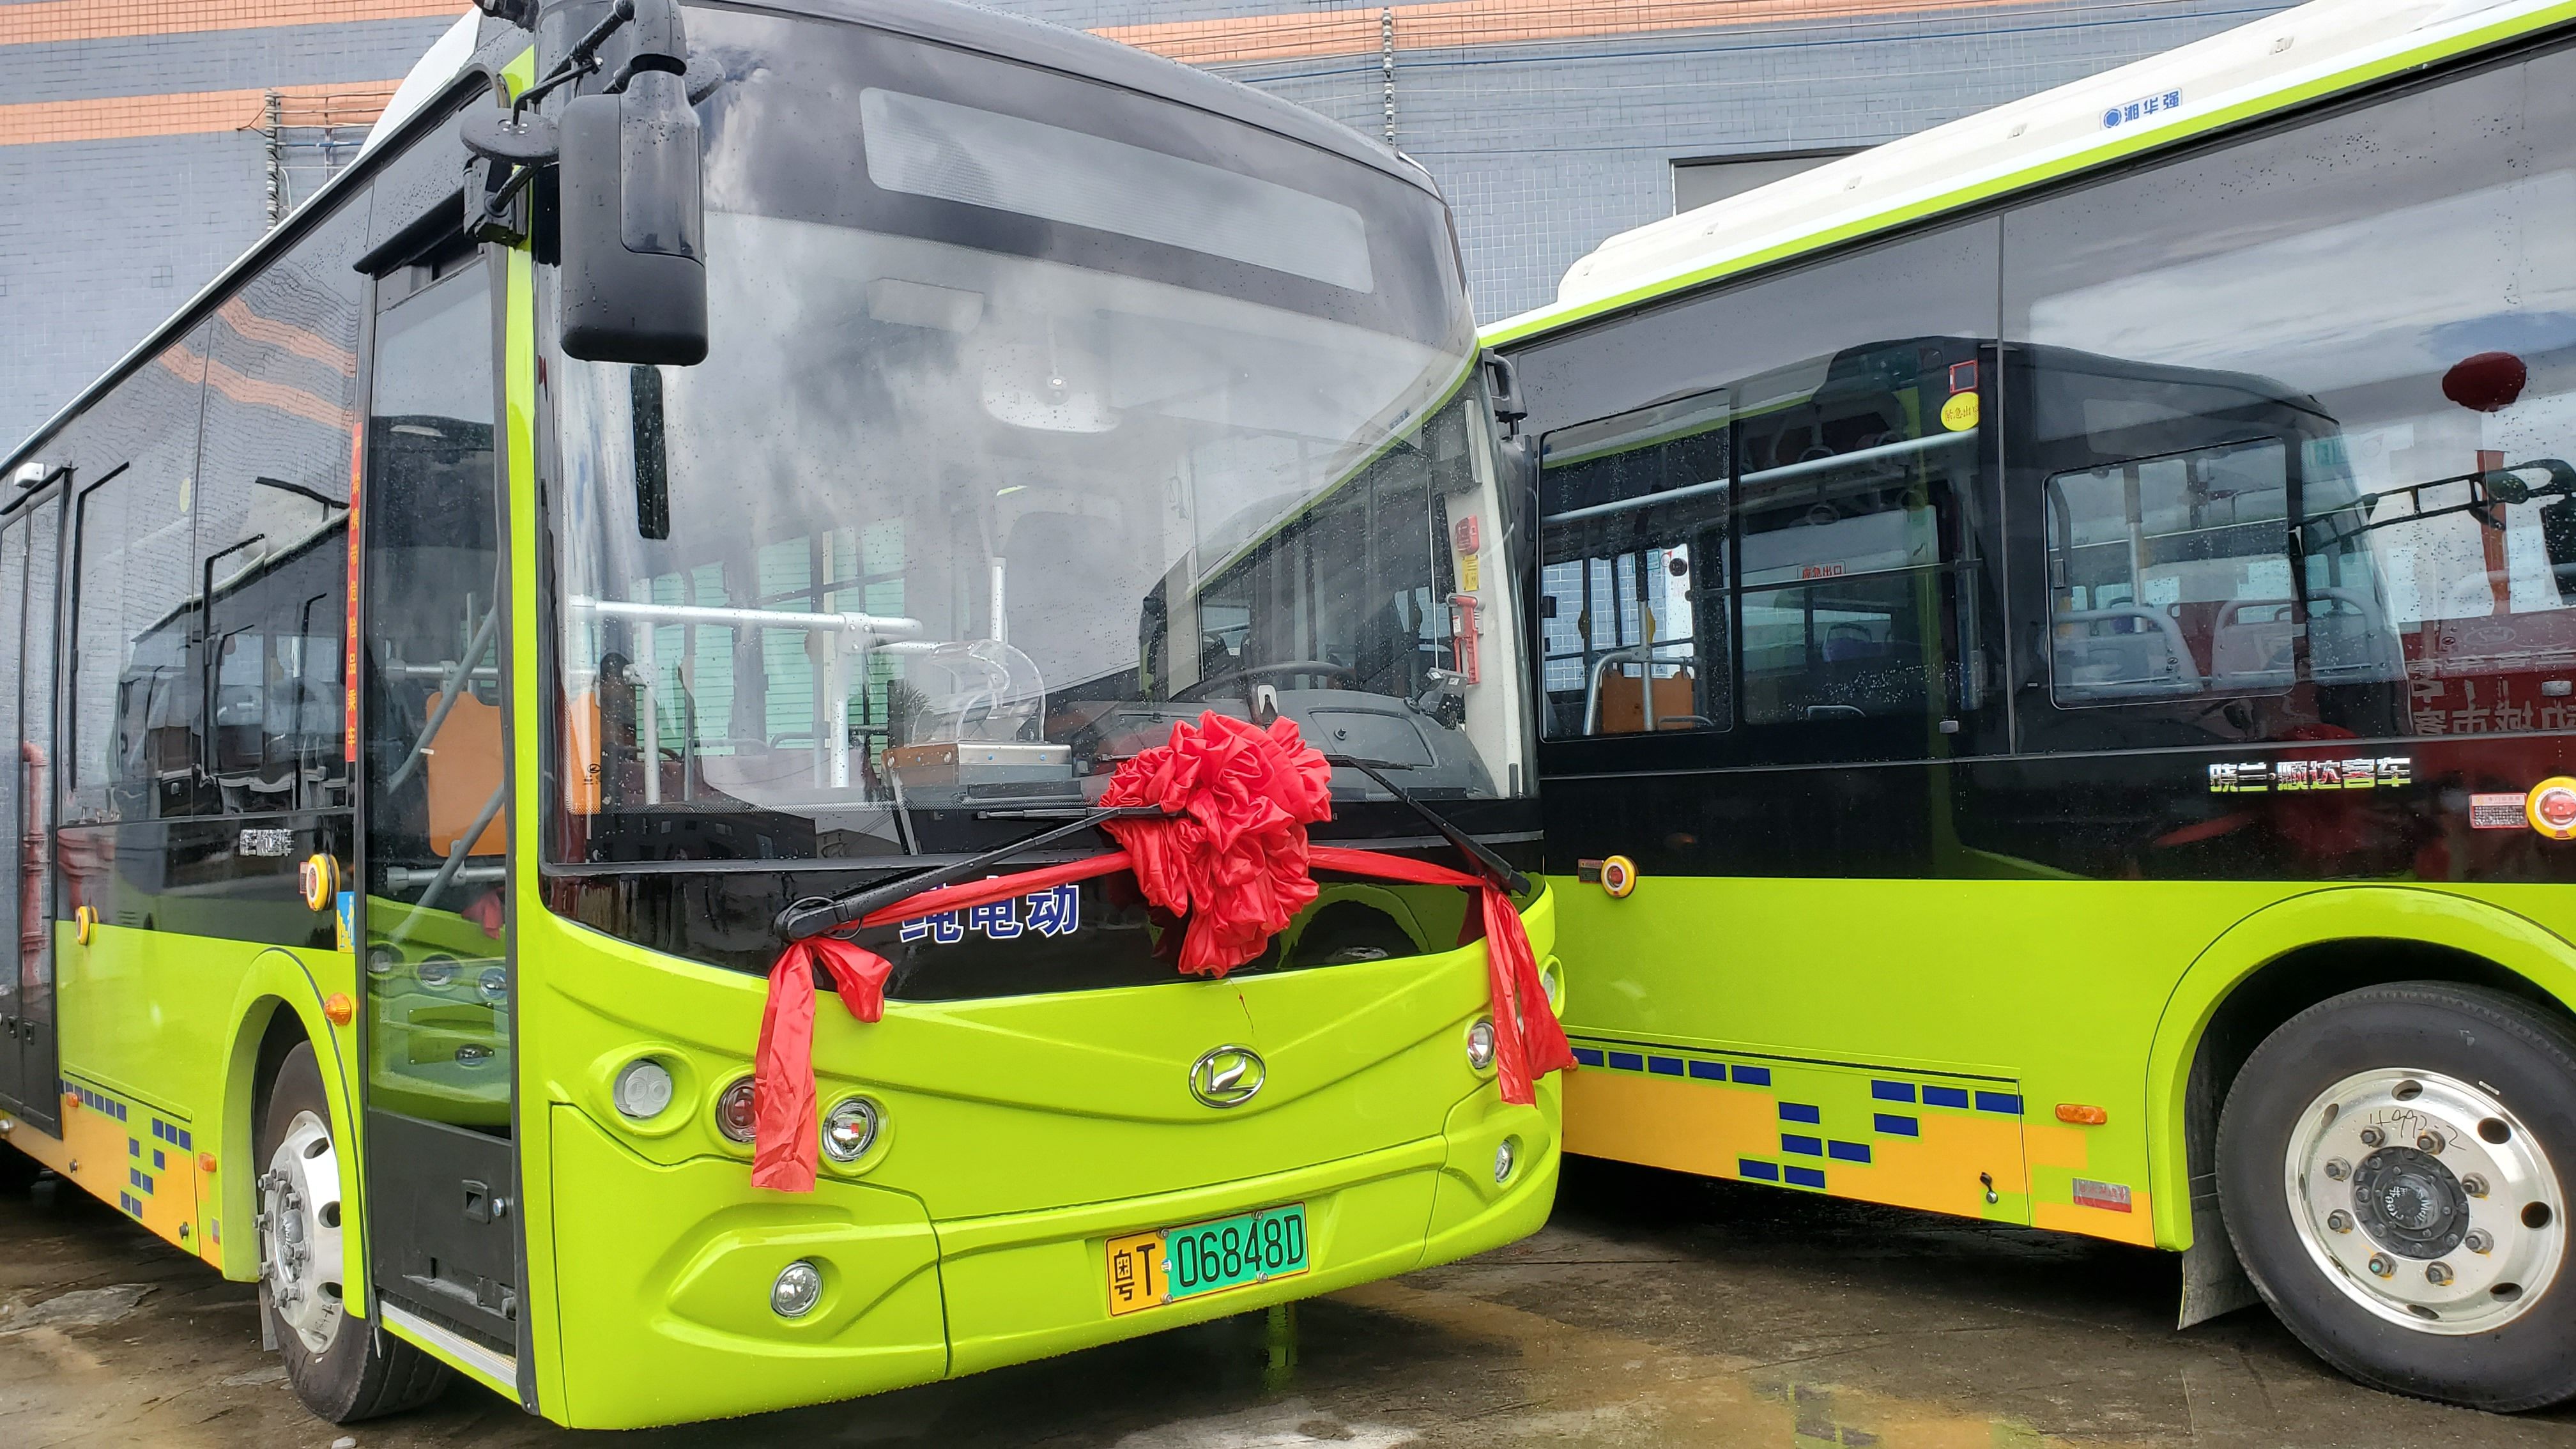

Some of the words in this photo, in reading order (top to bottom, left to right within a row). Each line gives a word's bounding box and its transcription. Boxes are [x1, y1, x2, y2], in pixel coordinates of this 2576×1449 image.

[2124, 90, 2179, 123] 湘华强
[1114, 1242, 1156, 1301] 粤T
[1177, 1214, 1305, 1287] 06848D
